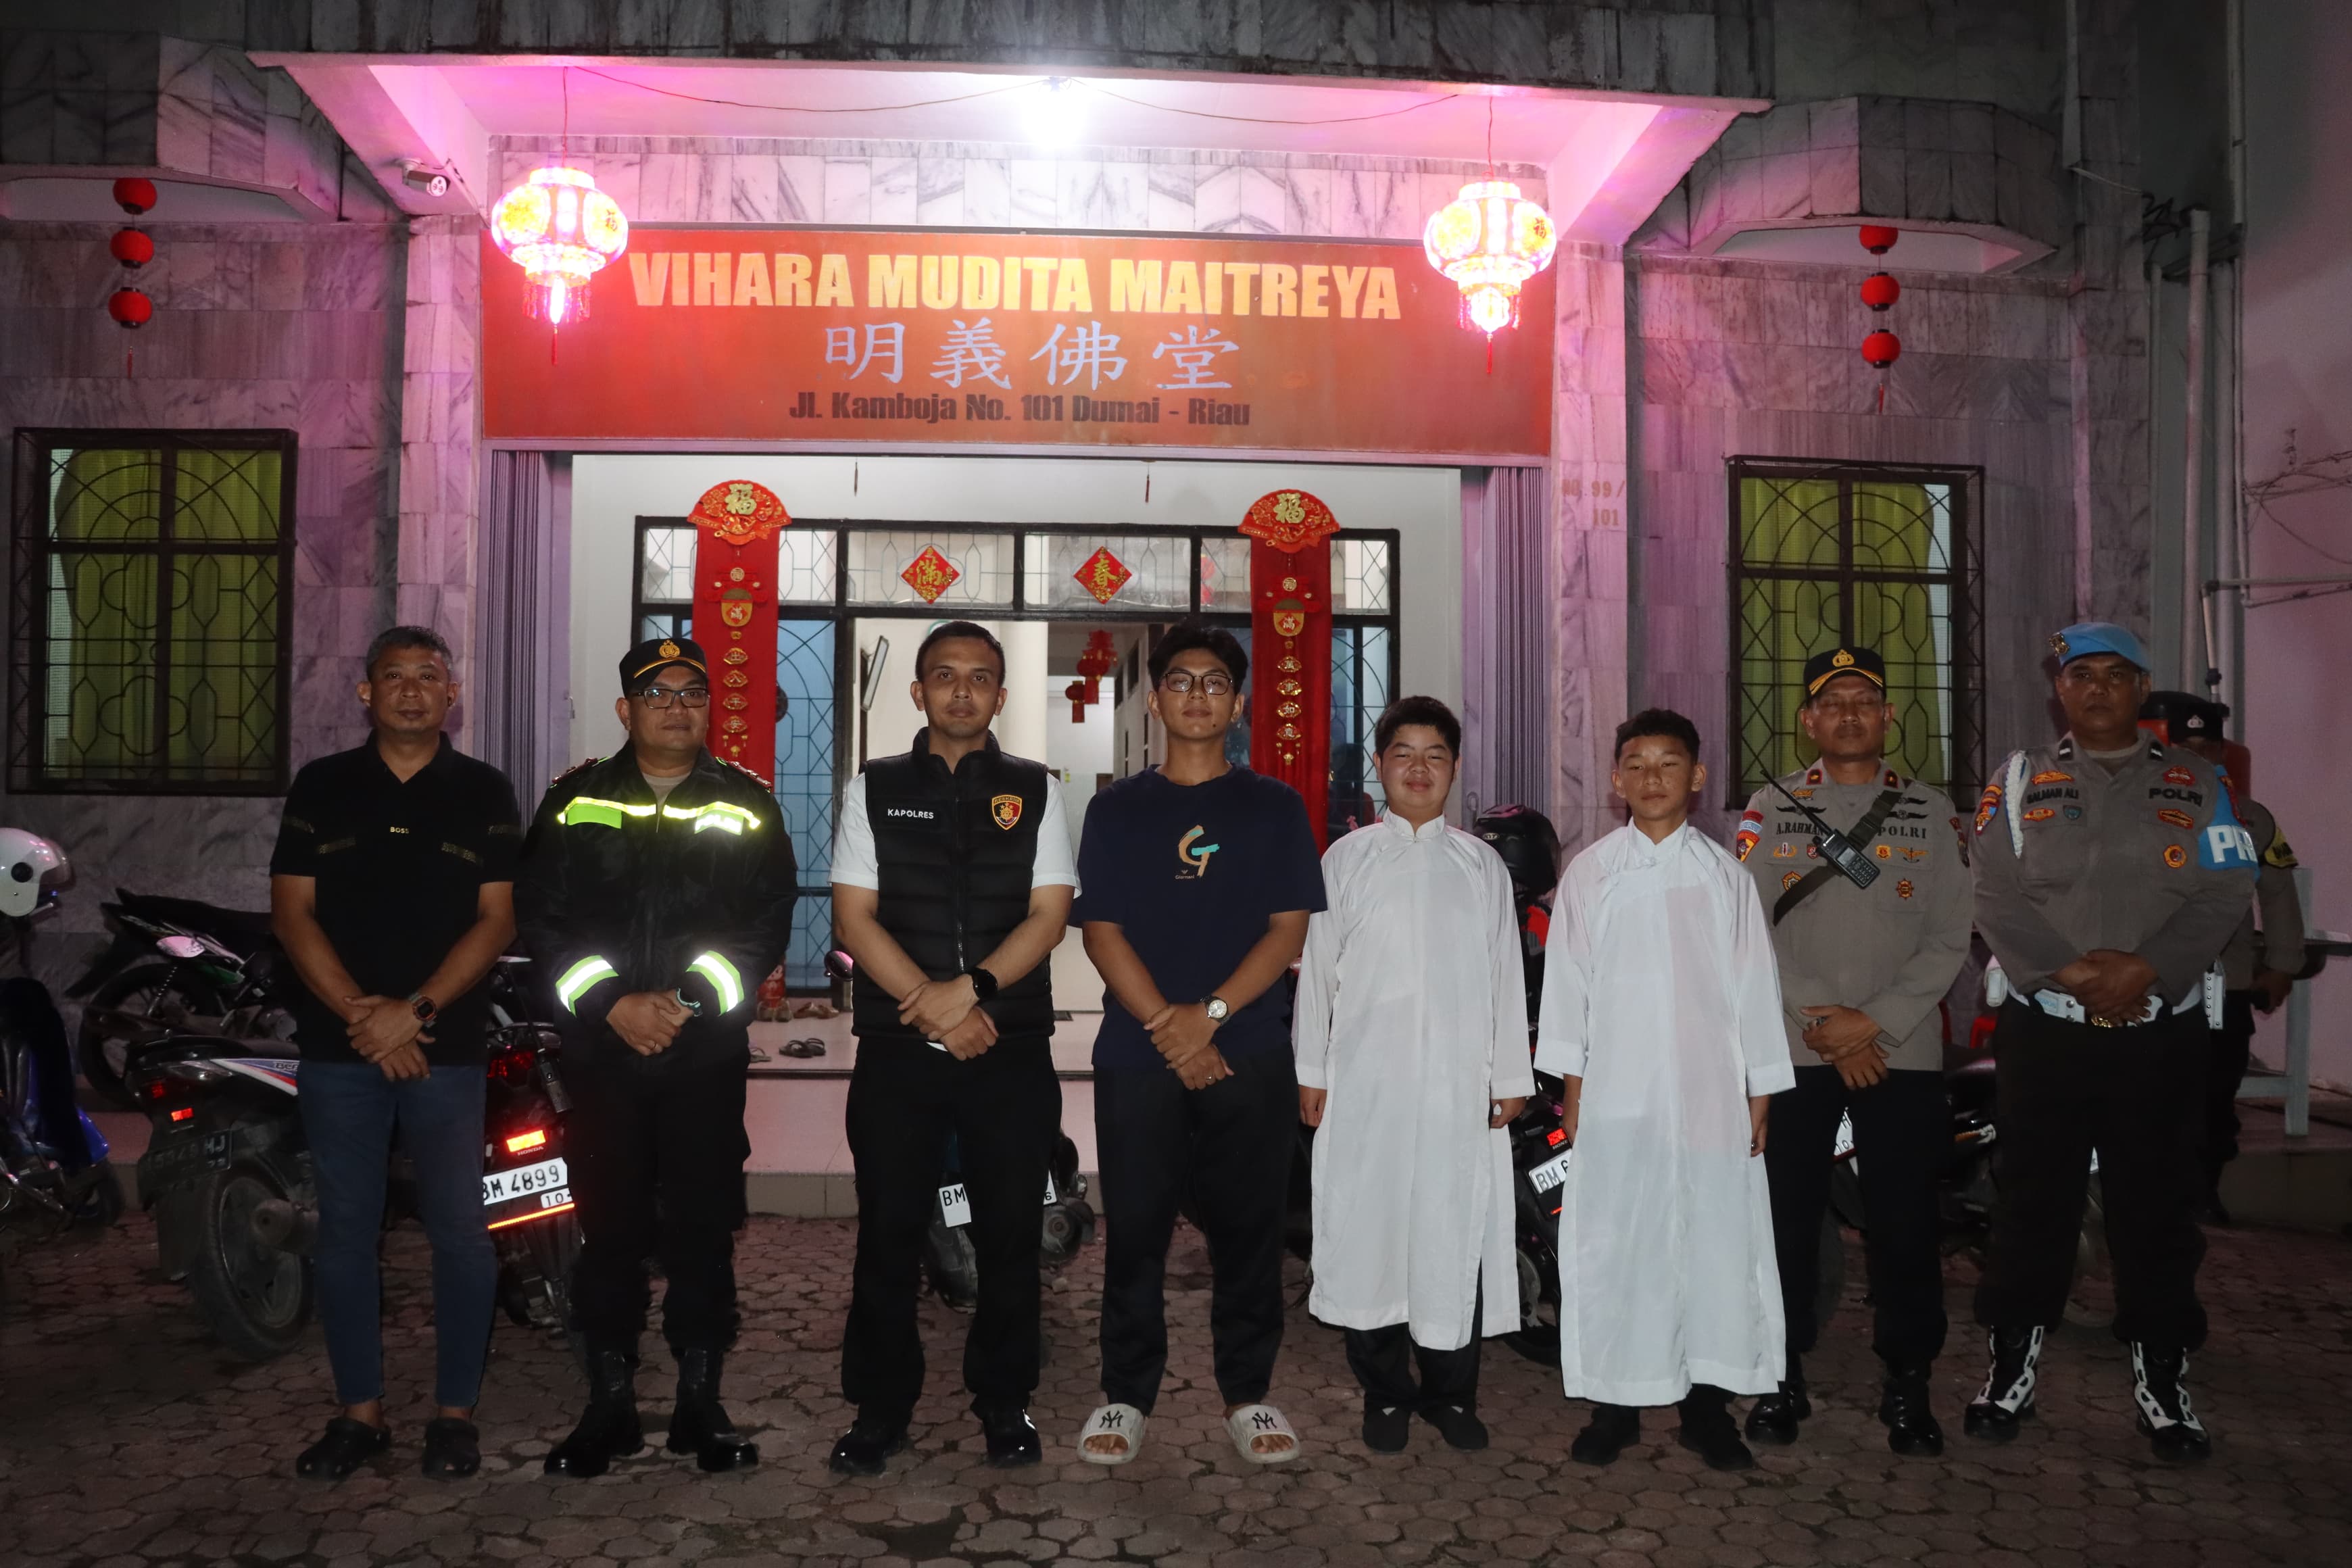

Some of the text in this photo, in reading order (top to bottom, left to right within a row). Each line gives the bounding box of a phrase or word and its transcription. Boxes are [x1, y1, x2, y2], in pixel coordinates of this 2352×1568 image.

[628, 252, 1401, 320] VIHARA MUDITA MAITREYA
[825, 317, 1239, 390] 明義佛堂
[789, 392, 822, 418] Jl.
[832, 392, 956, 424] Kamboja
[966, 393, 1011, 422] No.
[1021, 395, 1063, 422] 101
[1072, 395, 1160, 424] Dumai
[1188, 398, 1251, 426] Riau
[725, 483, 757, 516] 福
[1273, 493, 1306, 524] 福
[1593, 508, 1619, 526] 101
[2065, 787, 2079, 800] ALI
[2149, 788, 2203, 807] POLRI
[887, 808, 934, 819] KAPOLRES
[1878, 825, 1926, 839] POLRI
[518, 1146, 544, 1156] HONDA
[483, 1165, 560, 1201] BM 4899
[1536, 1167, 1561, 1192] BM
[942, 1187, 966, 1206] BM
